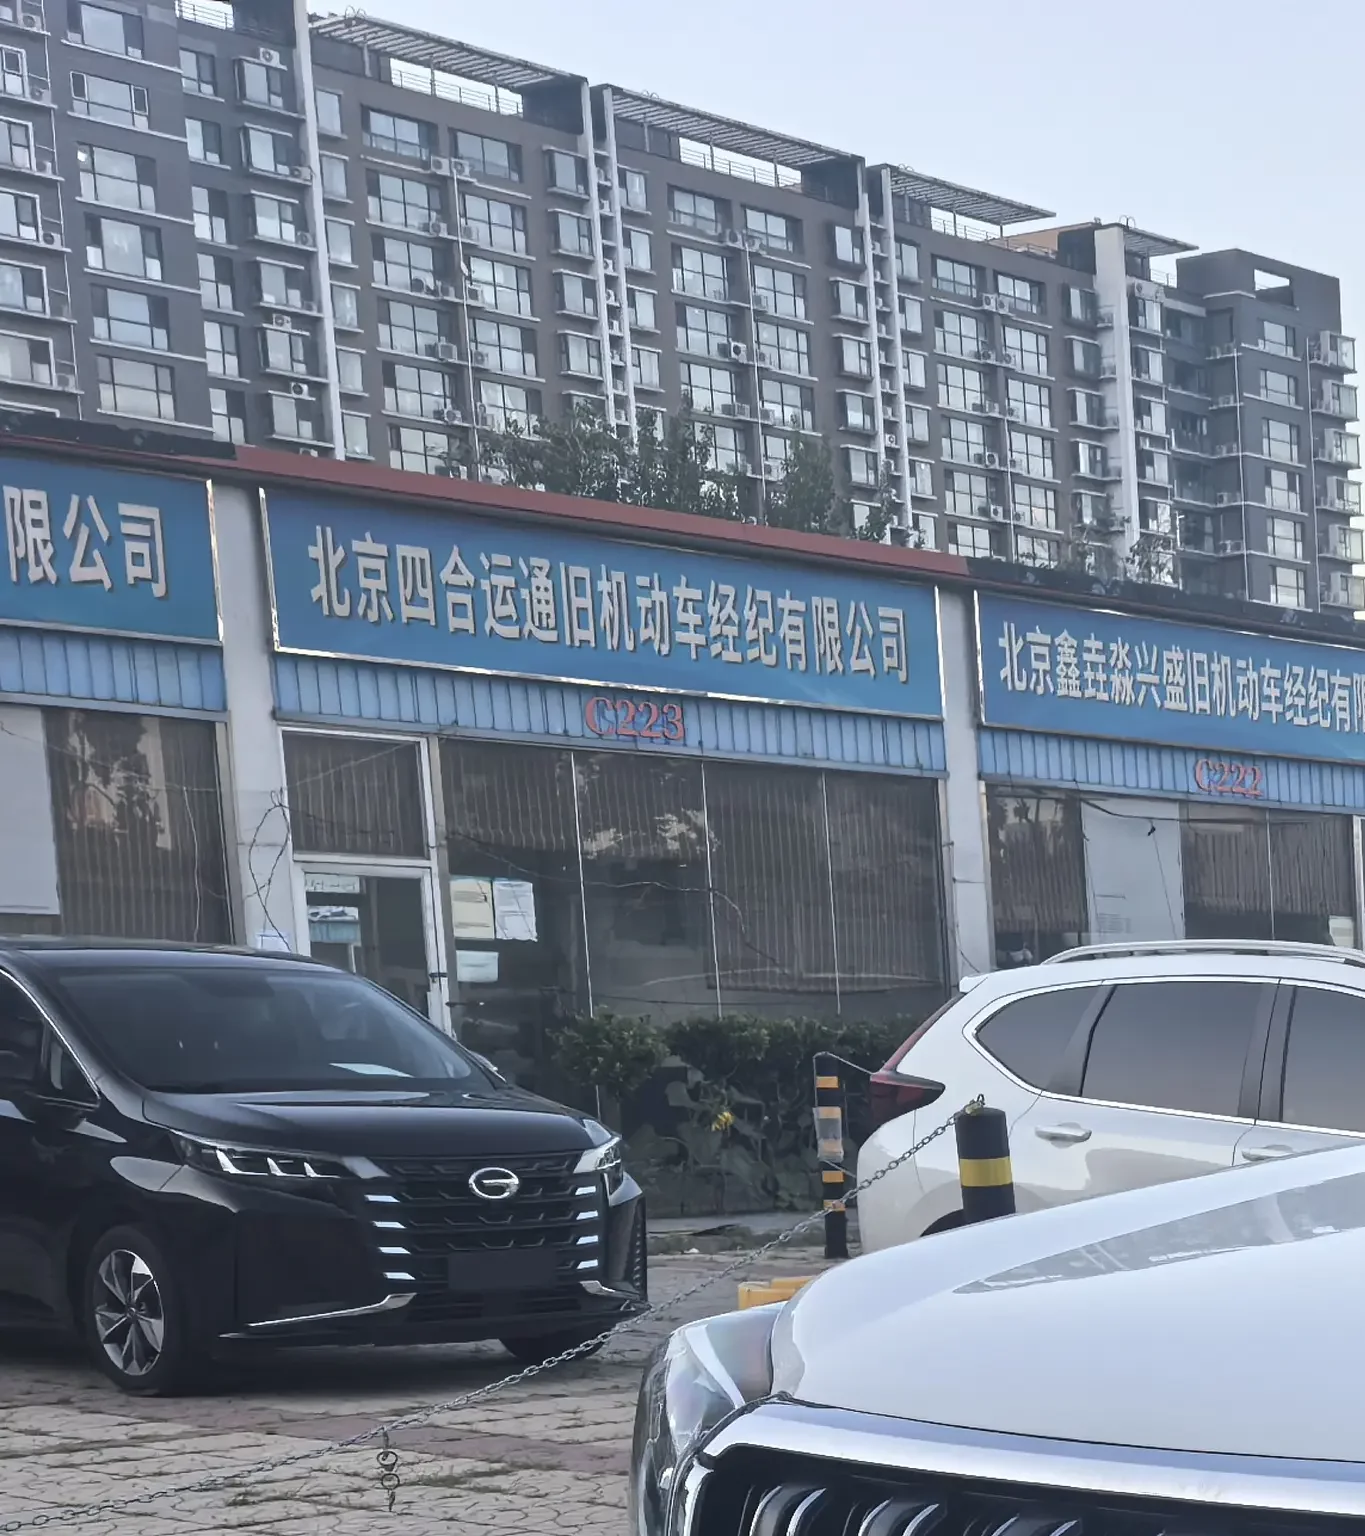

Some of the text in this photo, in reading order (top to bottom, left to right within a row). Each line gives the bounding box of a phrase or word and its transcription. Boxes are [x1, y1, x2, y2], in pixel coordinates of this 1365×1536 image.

[2, 485, 168, 599] 限公司
[307, 524, 910, 683] 北京四合运通旧机动车经纪有限公司
[585, 696, 686, 741] C223
[1194, 758, 1264, 799] C222
